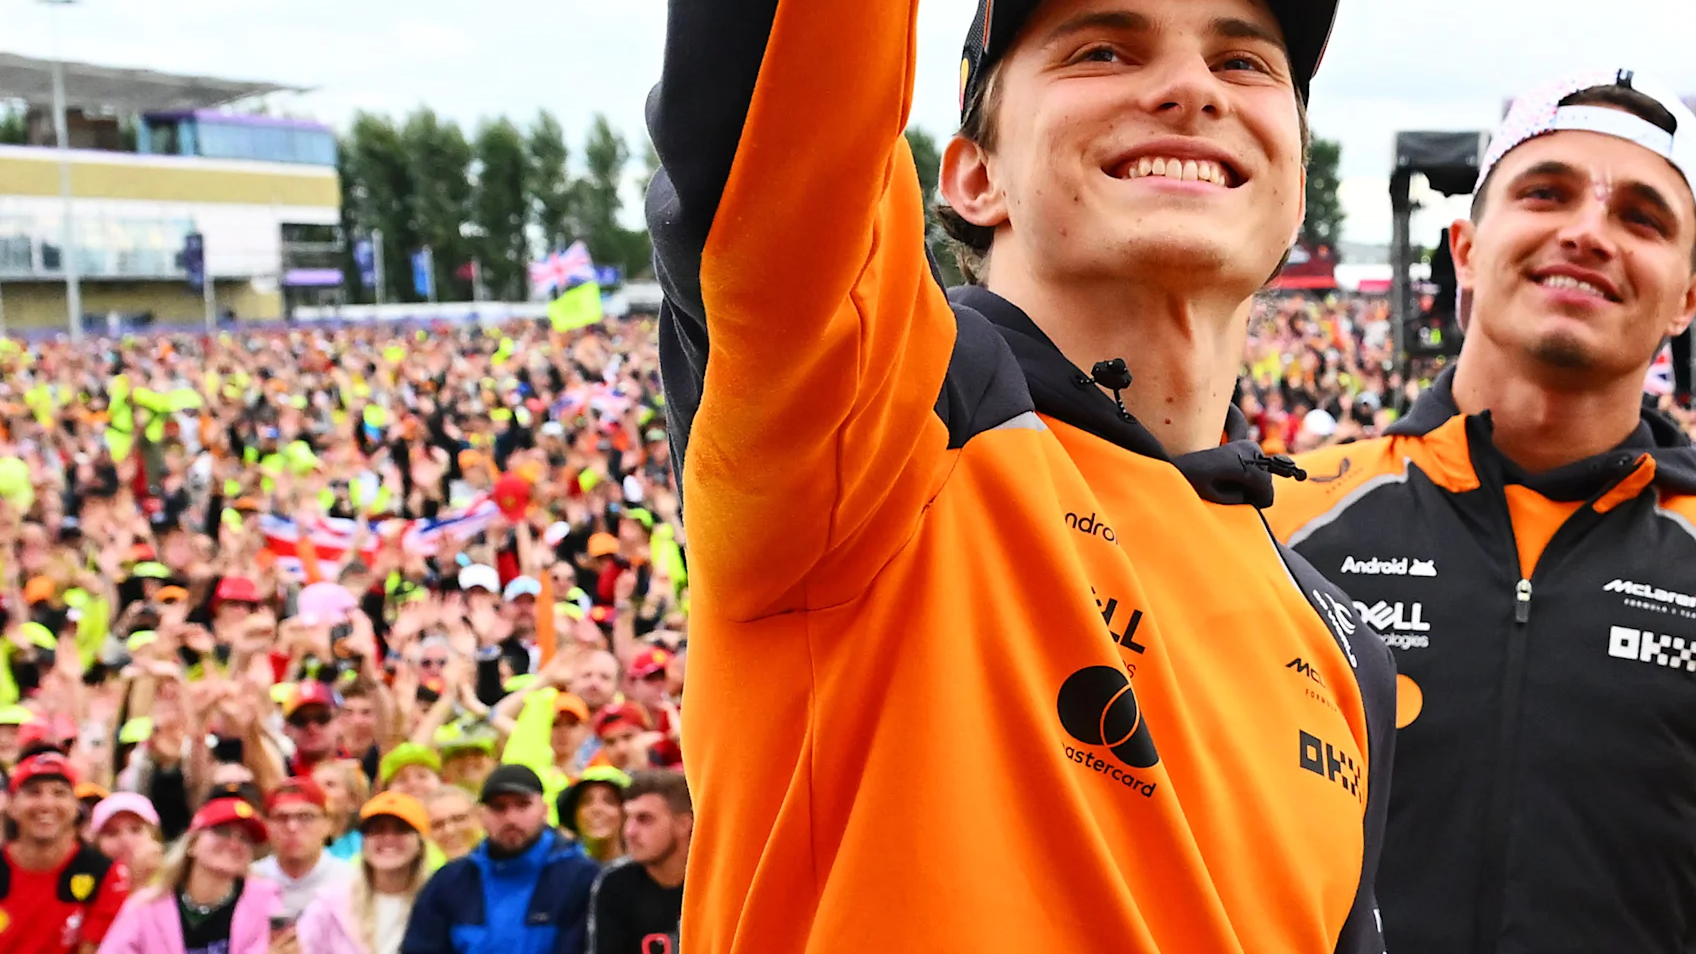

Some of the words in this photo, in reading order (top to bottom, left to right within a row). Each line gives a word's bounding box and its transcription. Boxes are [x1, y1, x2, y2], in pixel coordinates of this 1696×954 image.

[1064, 512, 1118, 545] ndro
[1340, 555, 1408, 575] Android
[1091, 586, 1146, 655] LL
[1380, 633, 1430, 651] ologies
[1062, 743, 1157, 798] astercard
